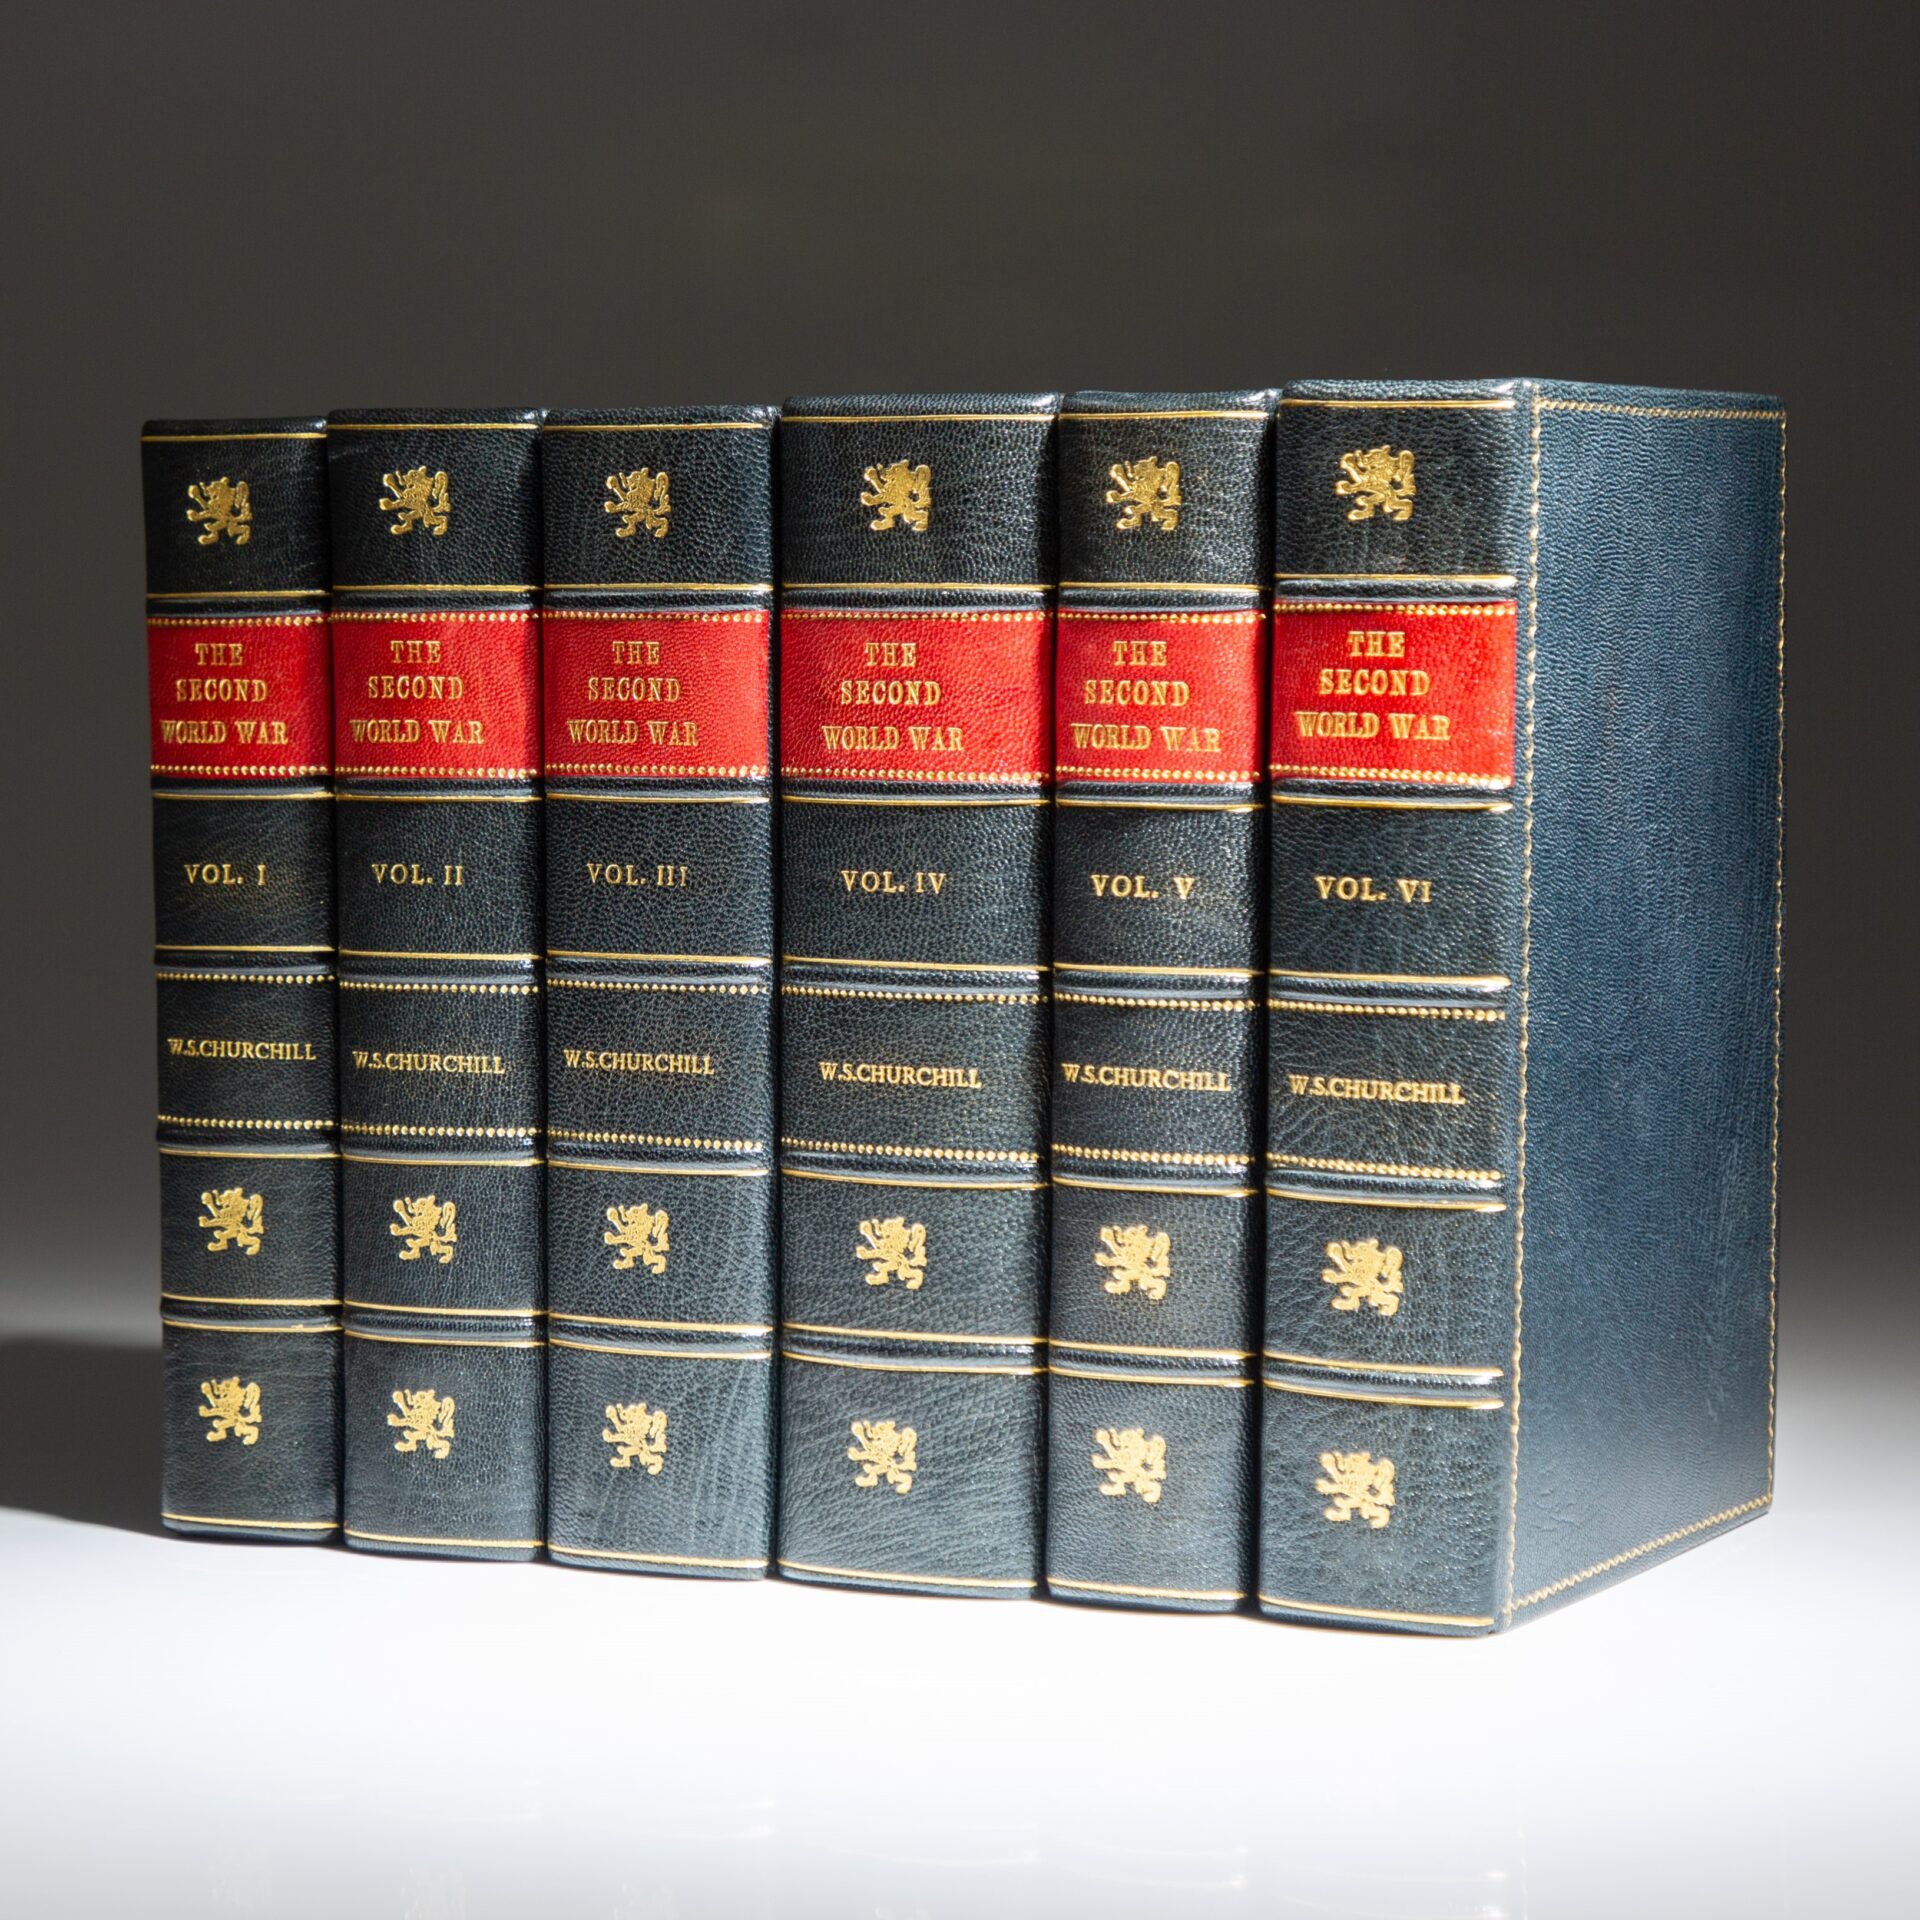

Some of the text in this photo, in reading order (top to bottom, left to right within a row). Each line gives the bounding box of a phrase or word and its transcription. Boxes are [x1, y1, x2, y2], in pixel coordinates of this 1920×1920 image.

[194, 643, 244, 666] THE
[390, 640, 441, 664] THE
[612, 641, 660, 664] THE
[865, 642, 917, 667] THE
[1112, 640, 1167, 666] THE
[1348, 631, 1405, 658] THE
[176, 679, 268, 702] SECOND
[368, 675, 464, 700] SECOND
[587, 677, 681, 702] SECOND
[840, 680, 941, 706] SECOND
[1085, 679, 1190, 707] SECOND
[1318, 669, 1430, 696] SECOND
[160, 720, 288, 745] WORLD WAR
[349, 720, 484, 744] WORLD WAR
[567, 719, 699, 746] WORLD WAR
[822, 725, 965, 752] WORLD WAR
[1071, 723, 1221, 753] WORLD WAR
[1296, 712, 1451, 741] WORLD WAR
[184, 864, 266, 885] VOL. I
[372, 863, 463, 886] VOL. II
[587, 863, 688, 887] VOL. III
[841, 870, 946, 894] VOL. IV
[1091, 874, 1195, 900] VOL. V
[1316, 875, 1432, 903] VOL. VI
[167, 1038, 316, 1060] W.S.CHURCHILL
[352, 1050, 506, 1074] W.S.CHURCHILL
[564, 1049, 714, 1076] W.S.CHURCHILL
[819, 1063, 982, 1089] W.S.CHURCHILL
